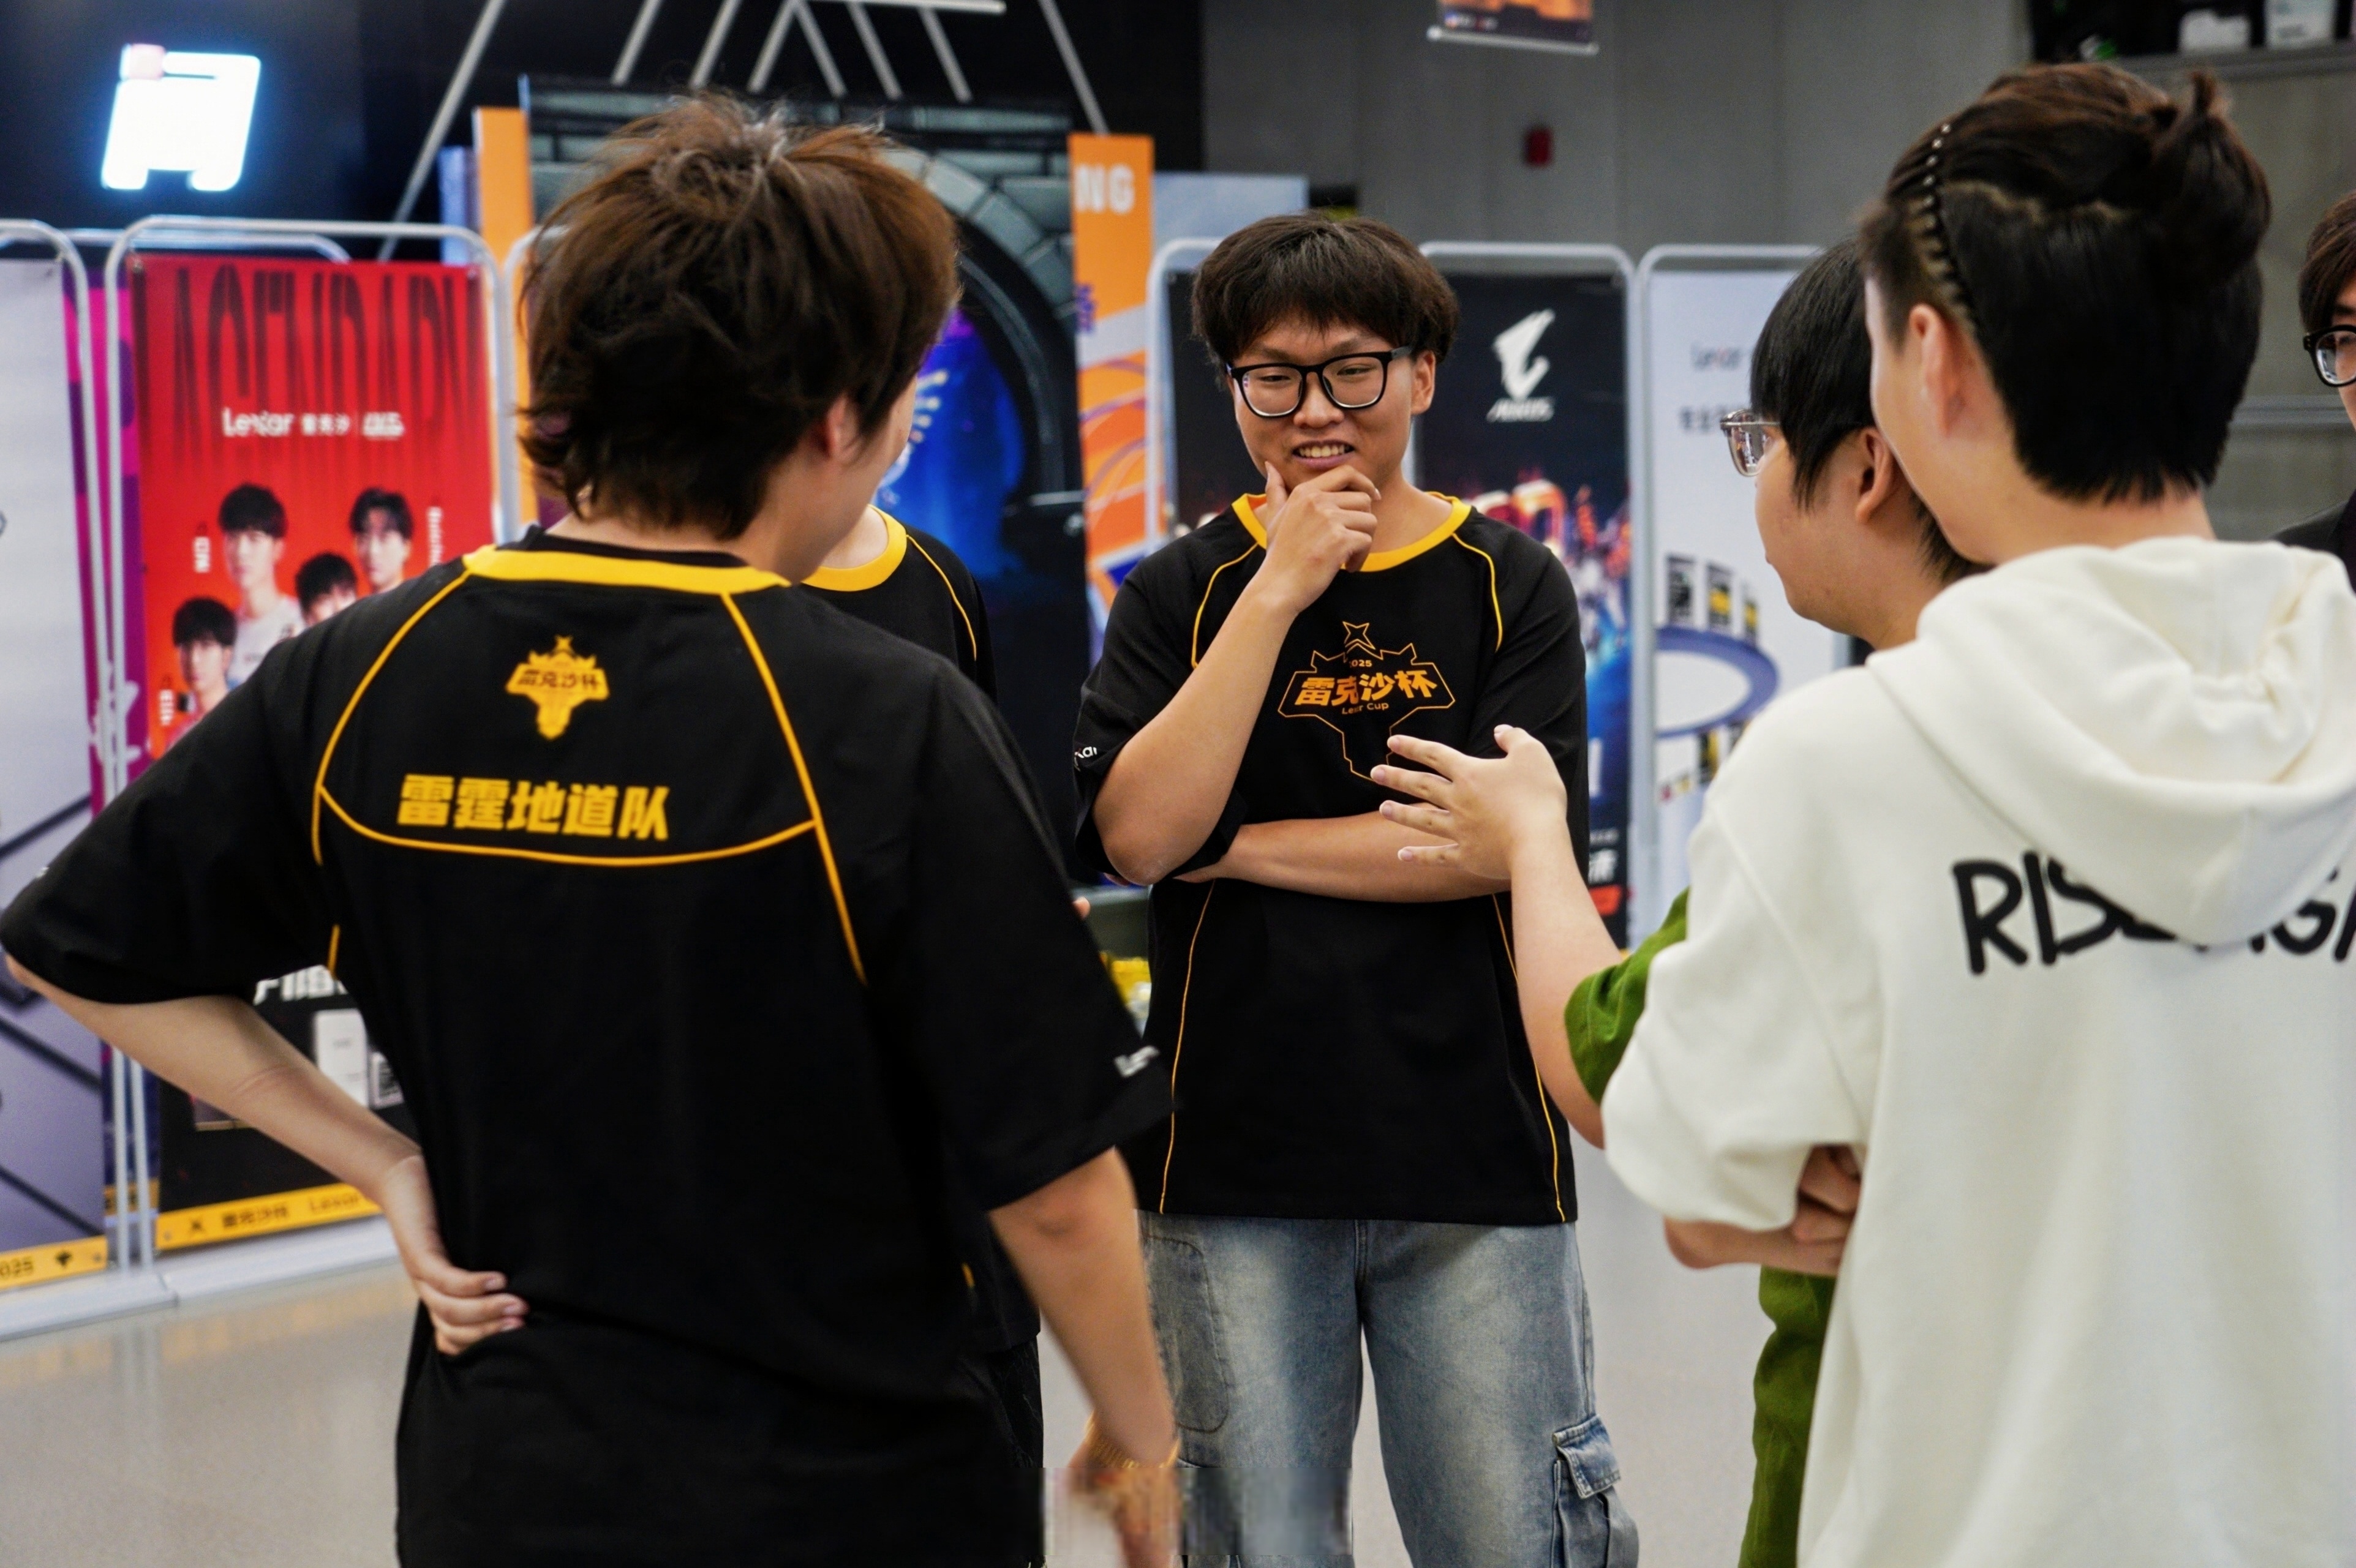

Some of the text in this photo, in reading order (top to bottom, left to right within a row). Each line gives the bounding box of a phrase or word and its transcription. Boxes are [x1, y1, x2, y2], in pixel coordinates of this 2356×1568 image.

[1349, 659, 1372, 668] 025
[1294, 670, 1437, 706] 雷克沙杯
[1366, 702, 1390, 711] Cup
[397, 773, 670, 841] 雷霆地道队
